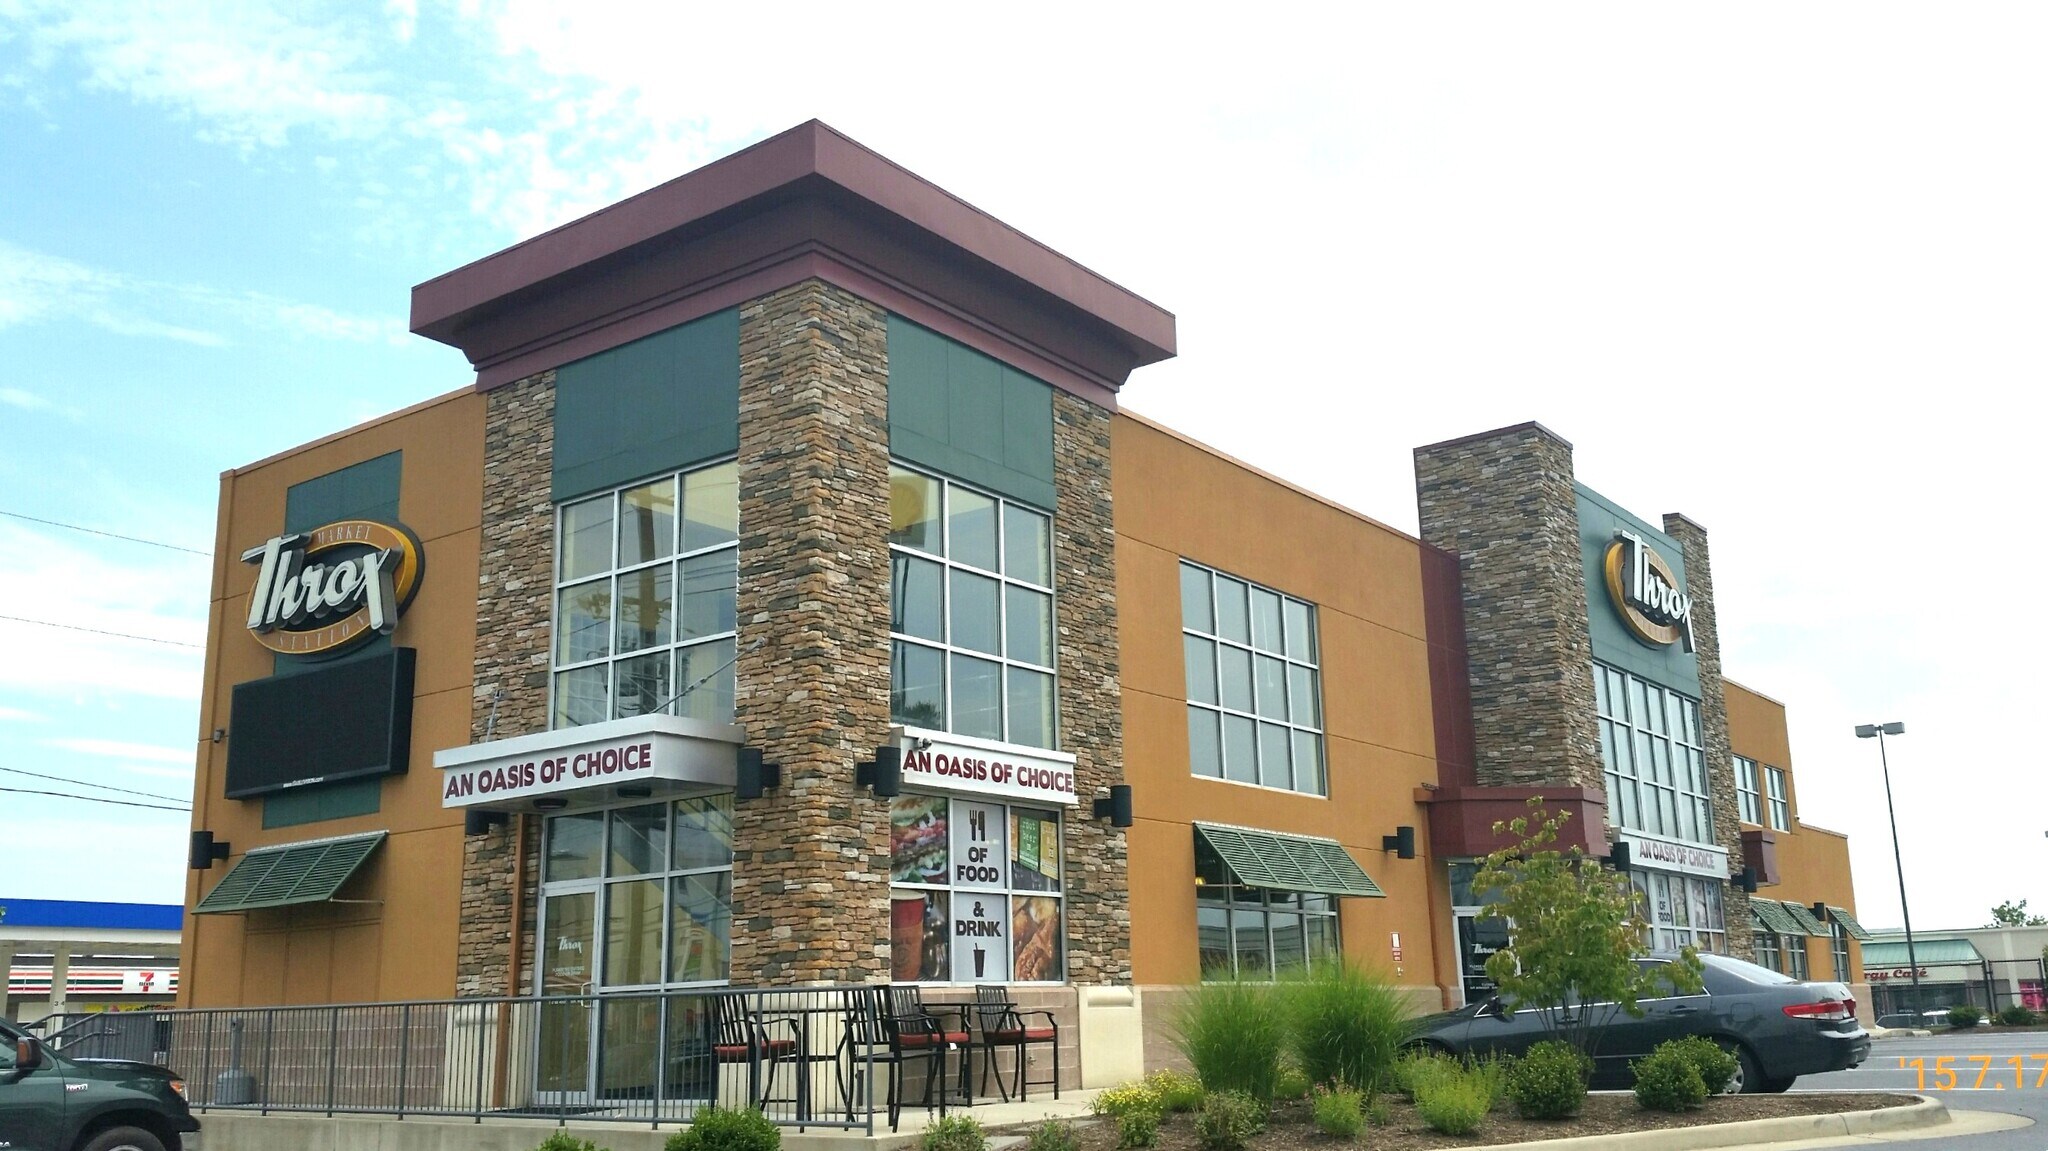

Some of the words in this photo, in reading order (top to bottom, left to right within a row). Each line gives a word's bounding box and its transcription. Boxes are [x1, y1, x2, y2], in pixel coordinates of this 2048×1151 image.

[317, 525, 372, 545] MARKET
[240, 533, 391, 630] Throx
[1621, 529, 1696, 653] Throx
[444, 772, 474, 799] AN
[477, 762, 535, 794] OASIS
[540, 756, 568, 784] OF
[572, 742, 652, 780] CHOICE
[903, 750, 931, 773] AN
[935, 753, 987, 781] OASIS
[991, 761, 1013, 784] OF
[1017, 766, 1073, 793] CHOICE
[967, 846, 988, 863] OF
[1639, 840, 1652, 859] AN
[1652, 842, 1676, 864] OASIS
[1676, 847, 1687, 865] OF
[1688, 849, 1715, 870] CHOICE
[956, 864, 999, 883] FOOD
[972, 901, 985, 918] &
[956, 919, 1002, 938] DRINK
[140, 972, 154, 992] 7
[1893, 967, 1928, 979] Caé
